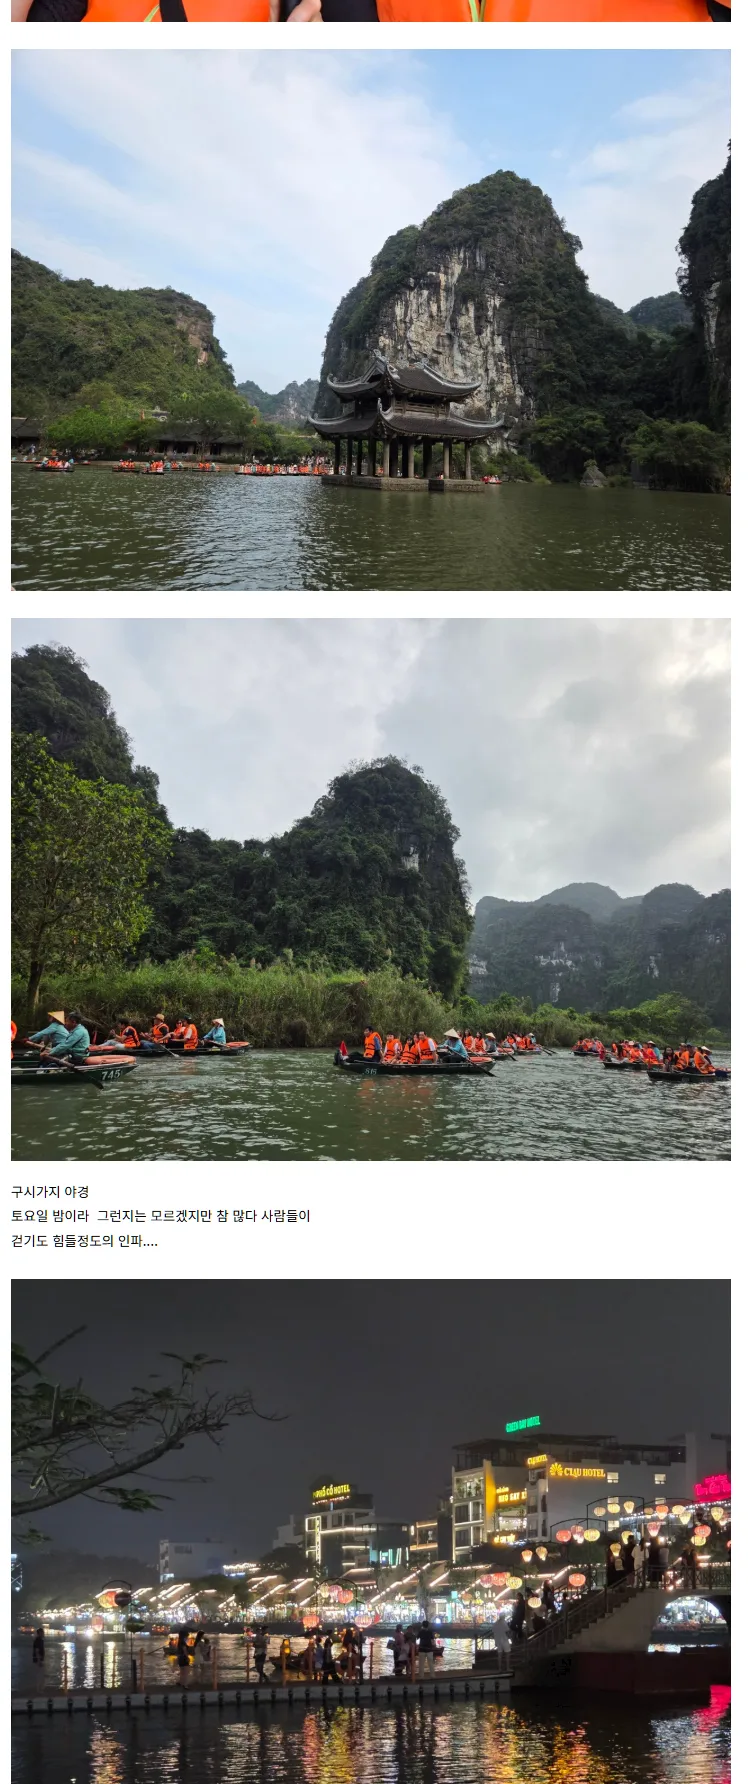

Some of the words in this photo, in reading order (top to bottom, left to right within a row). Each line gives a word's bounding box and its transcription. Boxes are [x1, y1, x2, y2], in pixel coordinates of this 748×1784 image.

[101, 1069, 121, 1081] 745
[583, 1468, 606, 1478] HOTEL
[333, 1484, 350, 1495] HOTEL
